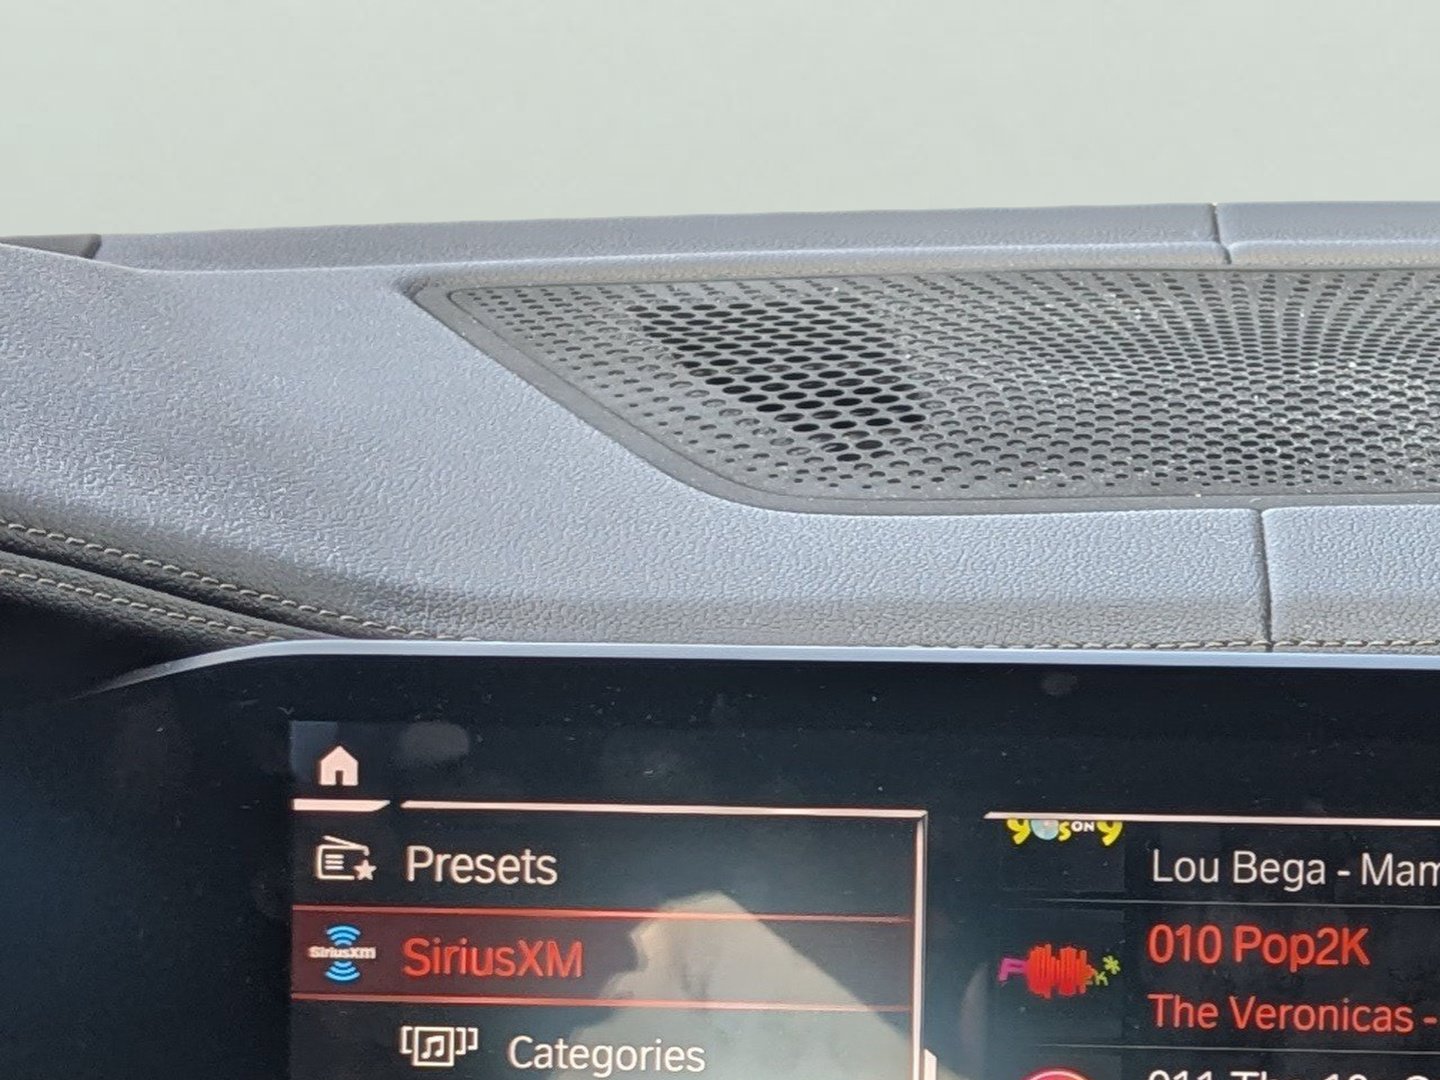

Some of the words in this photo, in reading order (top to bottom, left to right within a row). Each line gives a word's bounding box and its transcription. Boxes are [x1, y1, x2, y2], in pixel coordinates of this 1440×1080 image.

[405, 845, 558, 886] Presets
[1151, 849, 1220, 884] Lou
[1232, 851, 1326, 891] Bega
[403, 938, 585, 979] SiriusXM
[1148, 924, 1222, 964] 010
[1233, 926, 1371, 973] Pop2K
[1147, 993, 1219, 1029] The
[1229, 995, 1414, 1033] Veronicas
[507, 1036, 706, 1079] Categories
